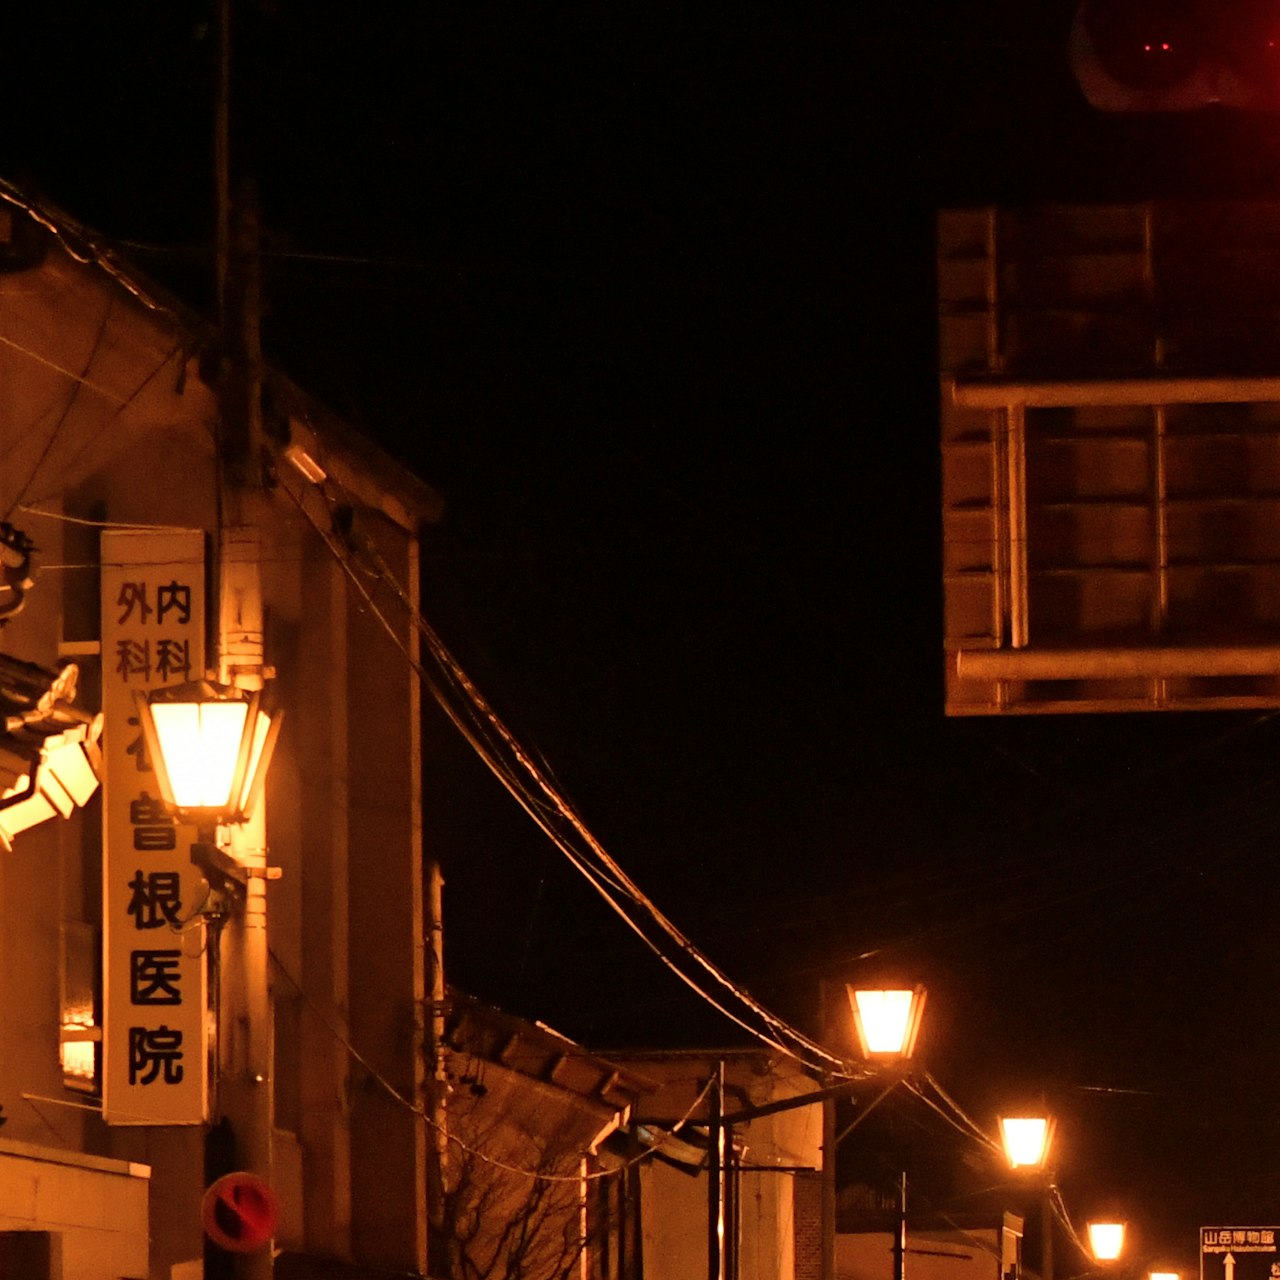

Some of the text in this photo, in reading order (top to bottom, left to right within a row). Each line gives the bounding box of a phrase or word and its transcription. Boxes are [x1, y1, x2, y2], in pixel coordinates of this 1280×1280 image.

[117, 582, 152, 682] 外科
[157, 580, 191, 682] 内科
[1204, 1230, 1275, 1244] 山岳博物館
